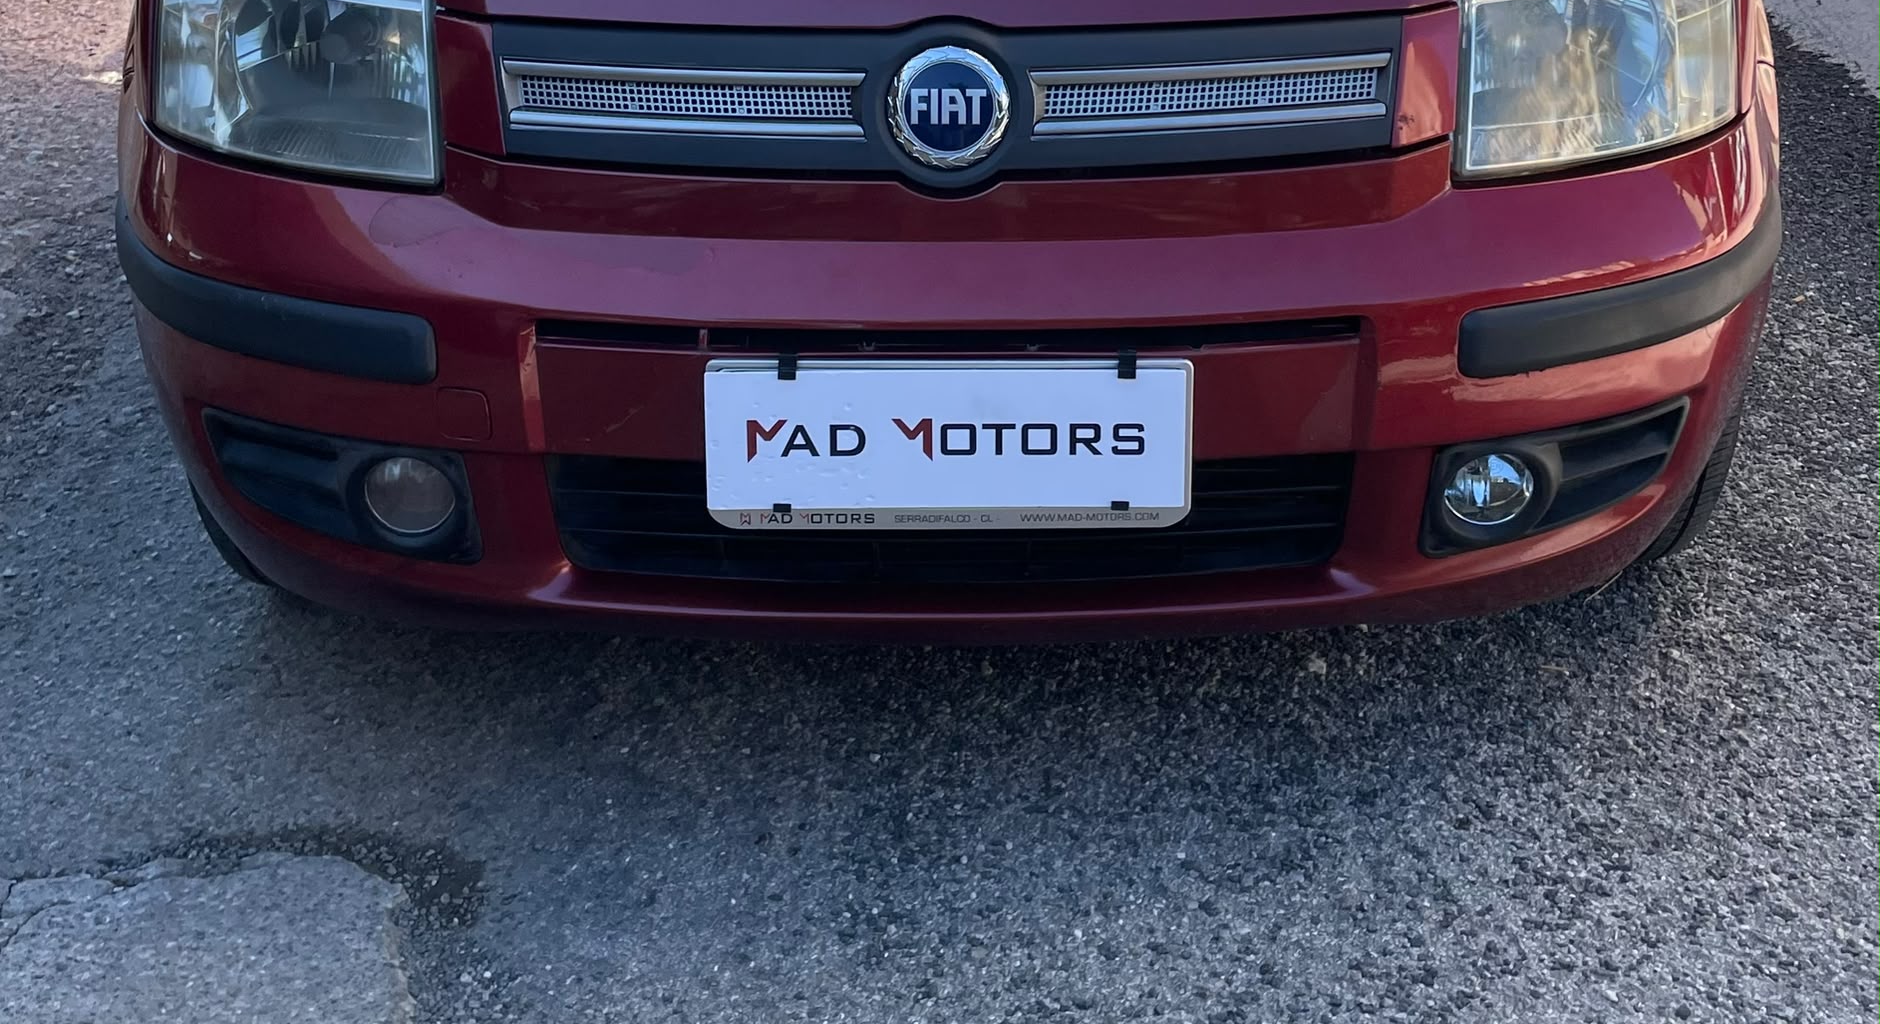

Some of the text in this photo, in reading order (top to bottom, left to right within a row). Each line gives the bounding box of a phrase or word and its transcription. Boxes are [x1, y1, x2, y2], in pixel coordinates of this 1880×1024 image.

[910, 88, 987, 125] FIAT
[746, 418, 1146, 463] MAD MOTORS
[760, 512, 793, 524] MAD
[799, 512, 875, 524] MOTORS
[1020, 512, 1160, 522] WWW.MAD-MOTORS.COM
